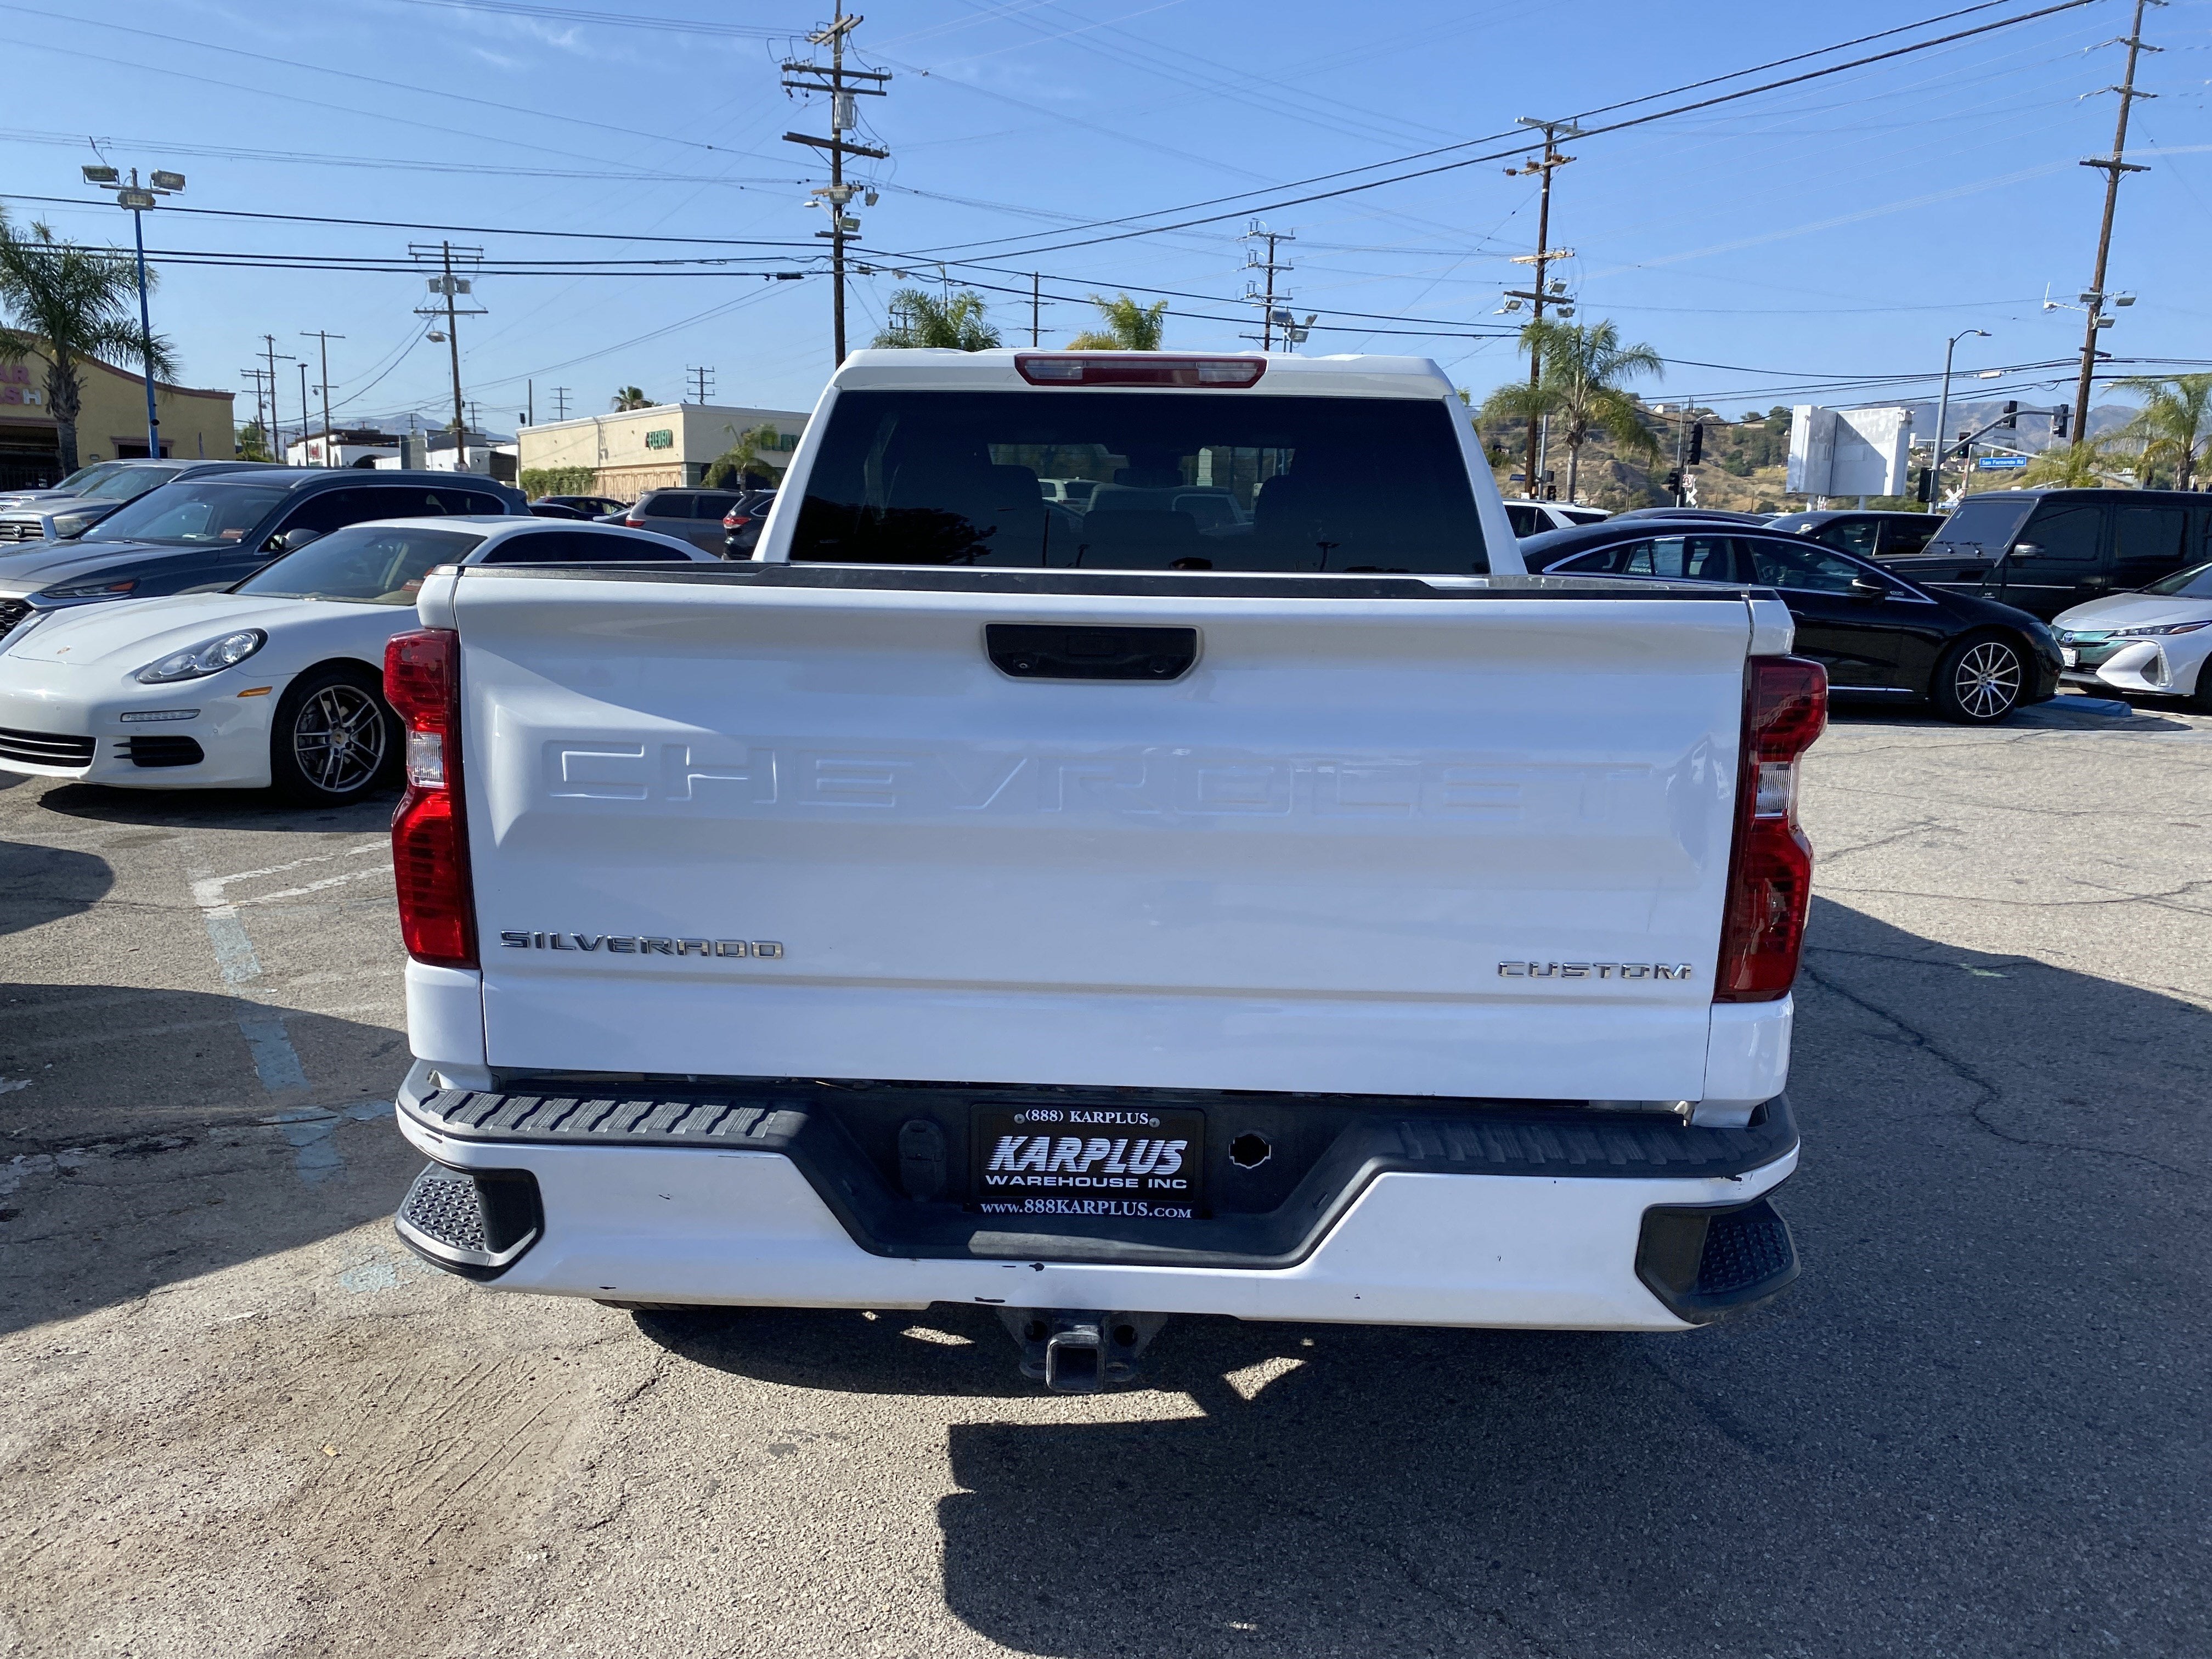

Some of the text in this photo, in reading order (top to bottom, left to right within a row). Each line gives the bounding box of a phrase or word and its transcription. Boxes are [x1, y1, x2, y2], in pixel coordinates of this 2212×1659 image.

[543, 738, 1652, 823] CHEVROLET
[500, 929, 784, 959] SILVERADO
[1498, 961, 1692, 979] CUSTOM
[1025, 1109, 1148, 1125] (888) KARPLUS
[986, 1136, 1188, 1175] KARPLUS
[985, 1175, 1187, 1189] WAREHOUSE INC
